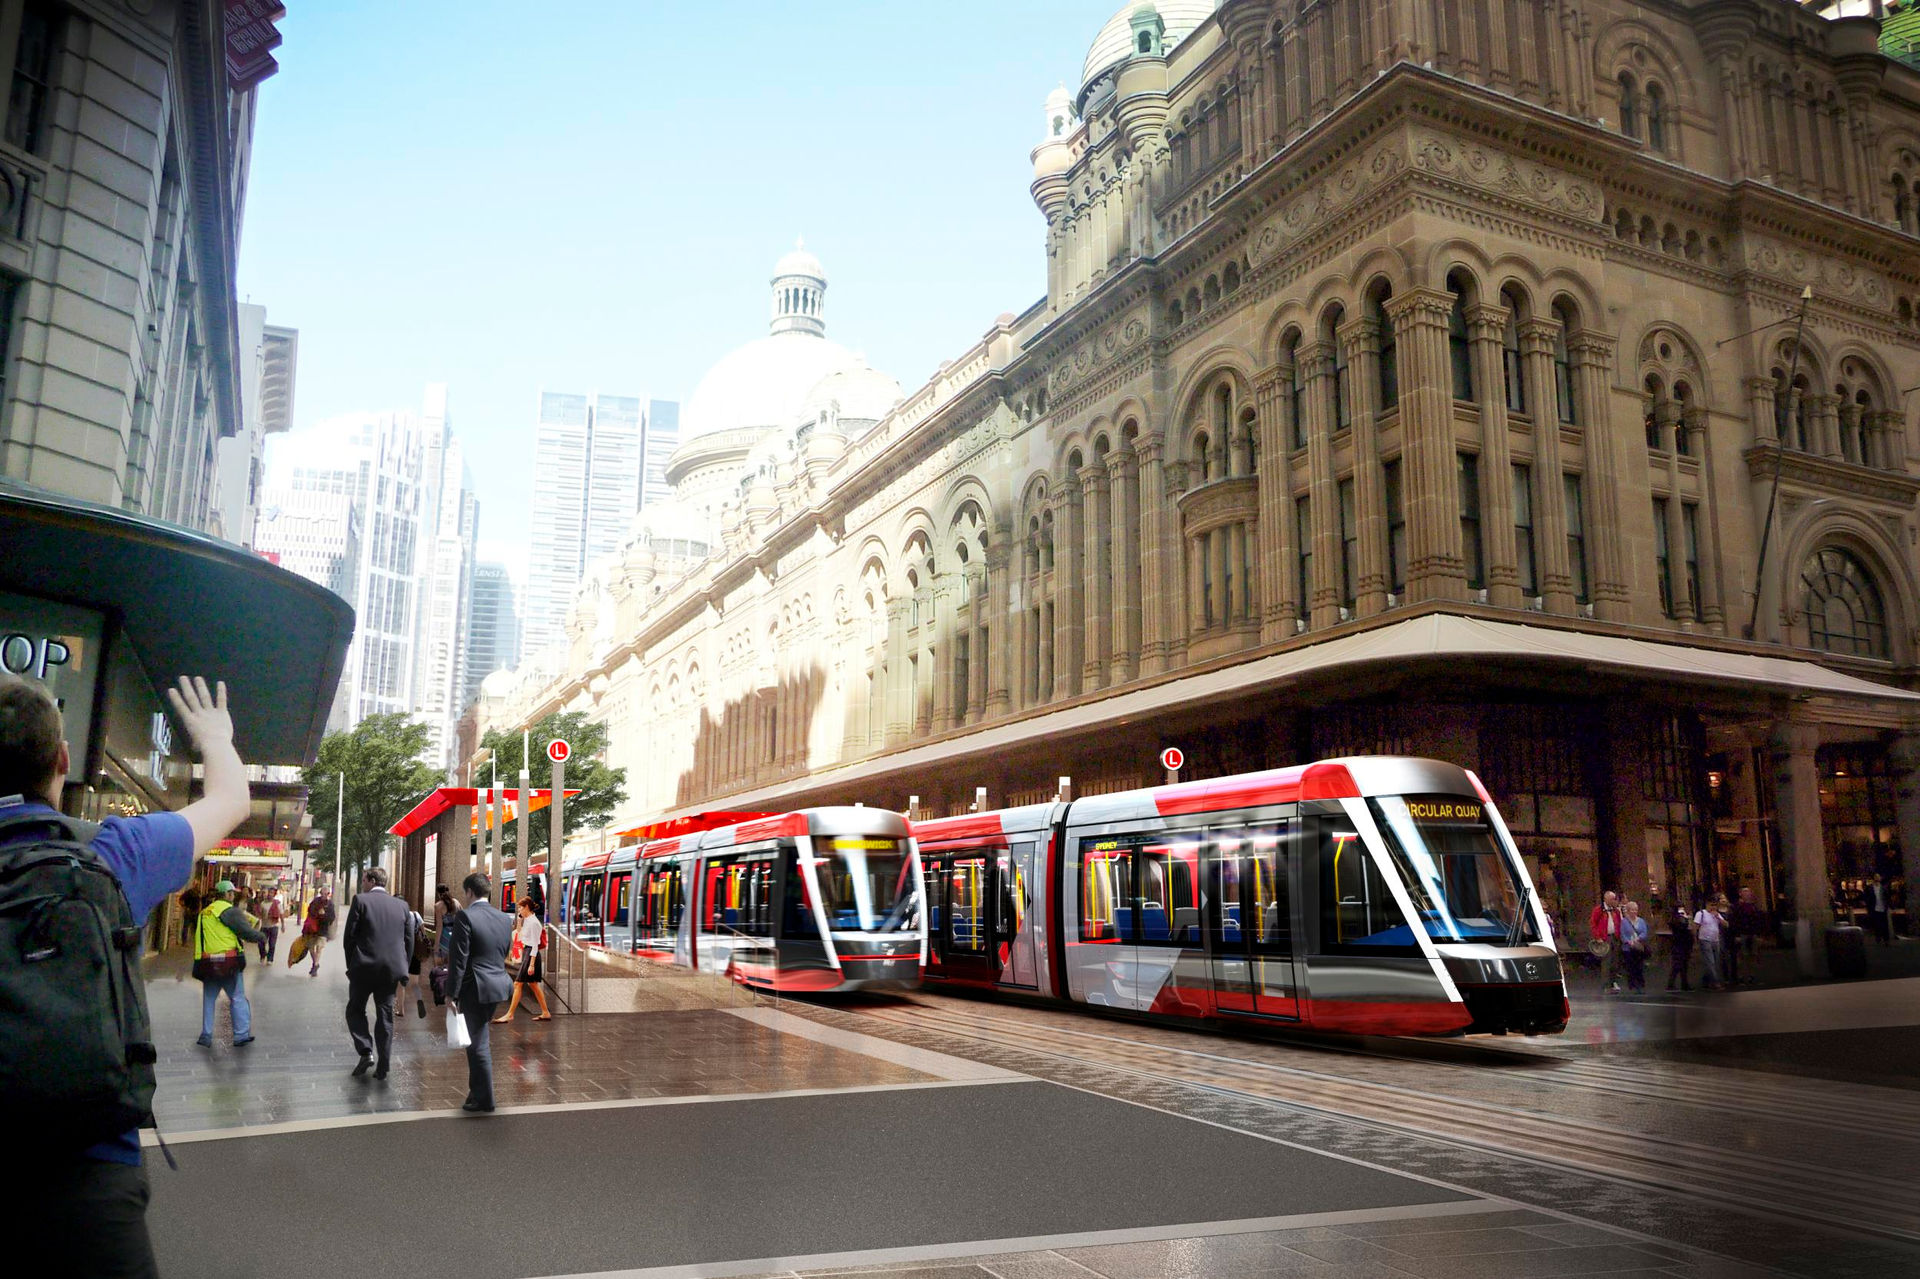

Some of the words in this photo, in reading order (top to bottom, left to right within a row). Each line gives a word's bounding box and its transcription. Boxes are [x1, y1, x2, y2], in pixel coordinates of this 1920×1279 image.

[228, 18, 276, 54] GRILL
[555, 743, 566, 758] L
[1169, 751, 1178, 765] L
[1399, 803, 1454, 818] CIRCULAR
[1455, 804, 1481, 818] QUAY
[829, 839, 894, 850] DWICK
[1095, 841, 1118, 850] SYDNEY
